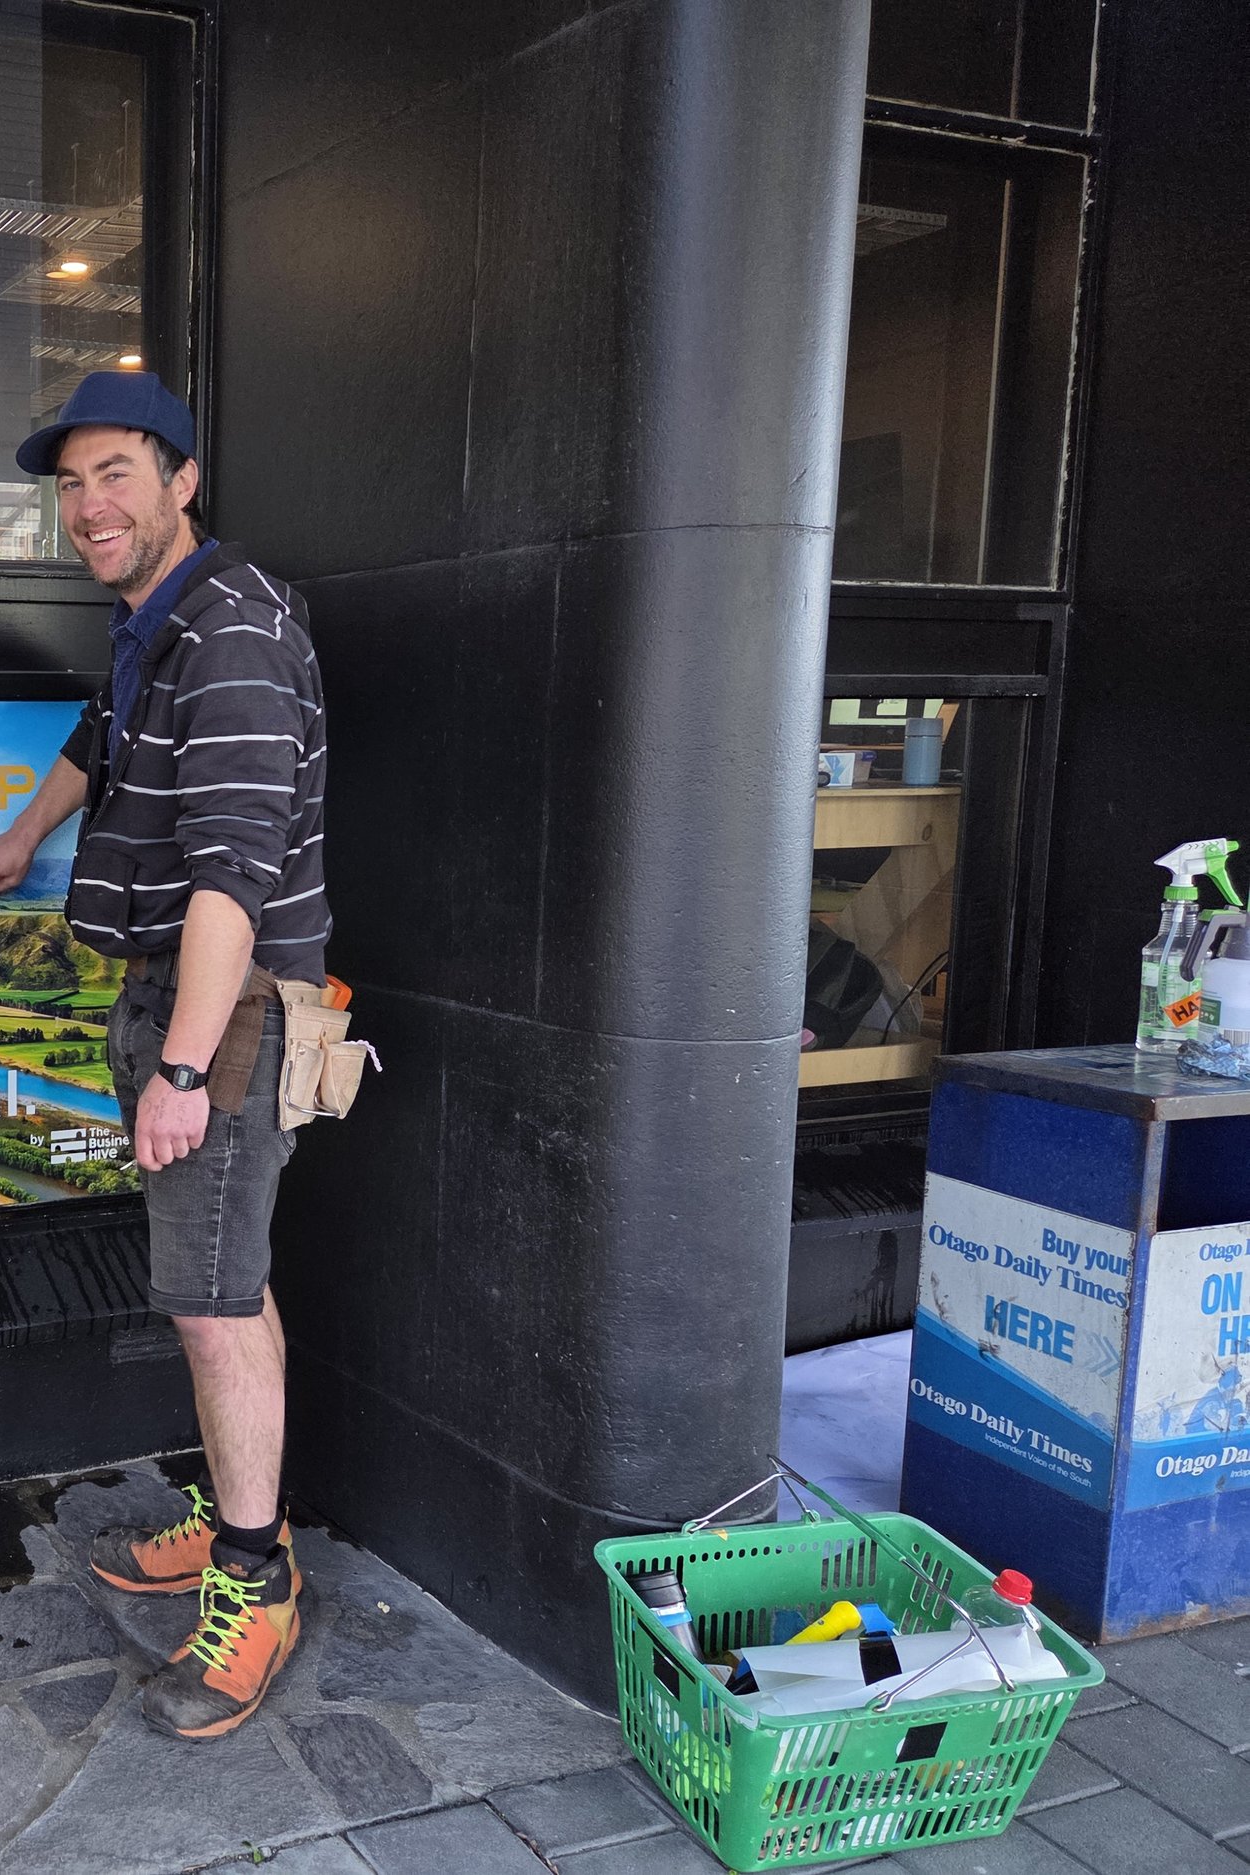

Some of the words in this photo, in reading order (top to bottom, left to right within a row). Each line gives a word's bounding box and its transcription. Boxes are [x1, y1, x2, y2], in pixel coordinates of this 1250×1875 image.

[1172, 996, 1201, 1021] HA
[30, 1134, 44, 1147] by
[88, 1127, 110, 1138] The
[88, 1135, 130, 1149] Busine
[928, 1224, 989, 1263] Otago
[993, 1244, 1052, 1286] Daily
[1056, 1266, 1128, 1309] Times
[1042, 1228, 1081, 1265] Buy
[1084, 1246, 1130, 1277] your
[1199, 1243, 1243, 1262] Otago
[1201, 1271, 1244, 1315] ON
[984, 1294, 1075, 1364] HERE
[910, 1378, 967, 1416] Otago
[970, 1402, 1025, 1444] Daily
[1027, 1428, 1093, 1473] Times
[984, 1432, 1027, 1458] Independent
[1027, 1452, 1048, 1468] Voice
[1056, 1466, 1069, 1478] the
[1069, 1471, 1092, 1488] South
[1155, 1454, 1217, 1478] Otago
